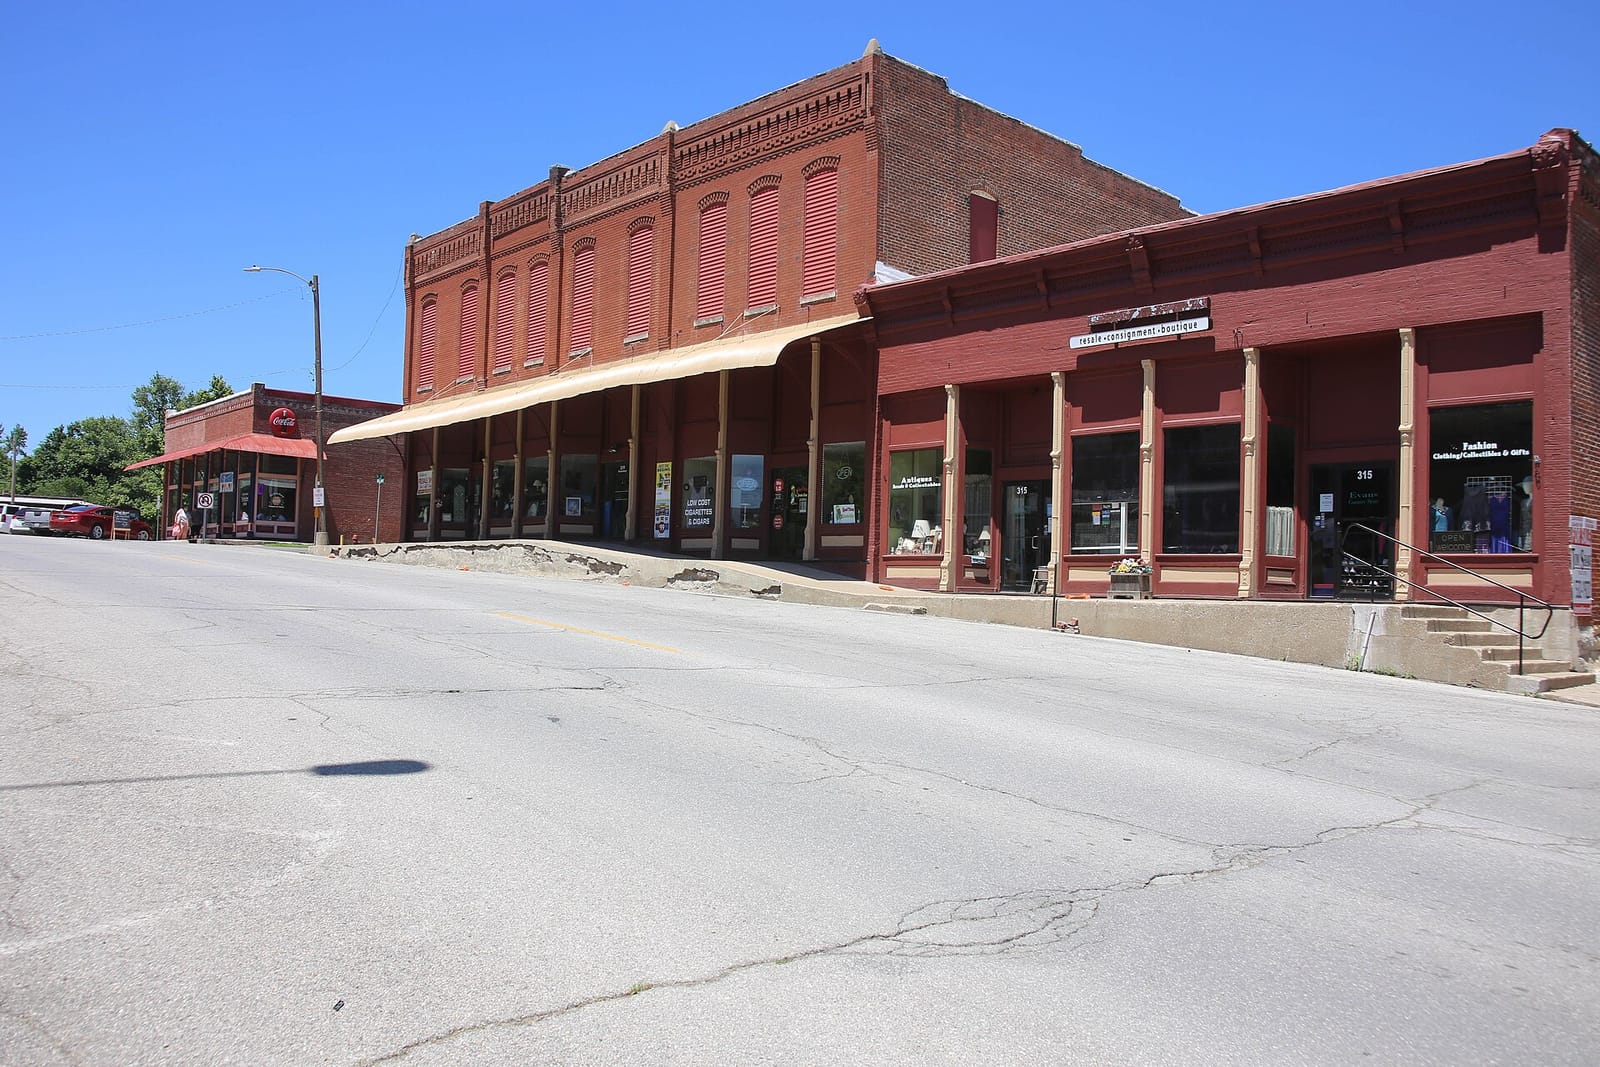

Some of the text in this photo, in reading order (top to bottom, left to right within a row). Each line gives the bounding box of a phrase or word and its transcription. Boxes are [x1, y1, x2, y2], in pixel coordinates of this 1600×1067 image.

[1079, 320, 1198, 345] resale consignment boutique
[1462, 441, 1498, 451] Fashion
[1502, 449, 1509, 457] &
[1510, 448, 1530, 456] Gifts
[1356, 470, 1373, 480] 315
[901, 476, 932, 484] Antiques
[1016, 486, 1028, 495] 315
[687, 498, 711, 507] LOW COST
[684, 508, 713, 516] CIGARETTES
[1441, 534, 1465, 542] OPEN
[1434, 542, 1471, 551] welcome
